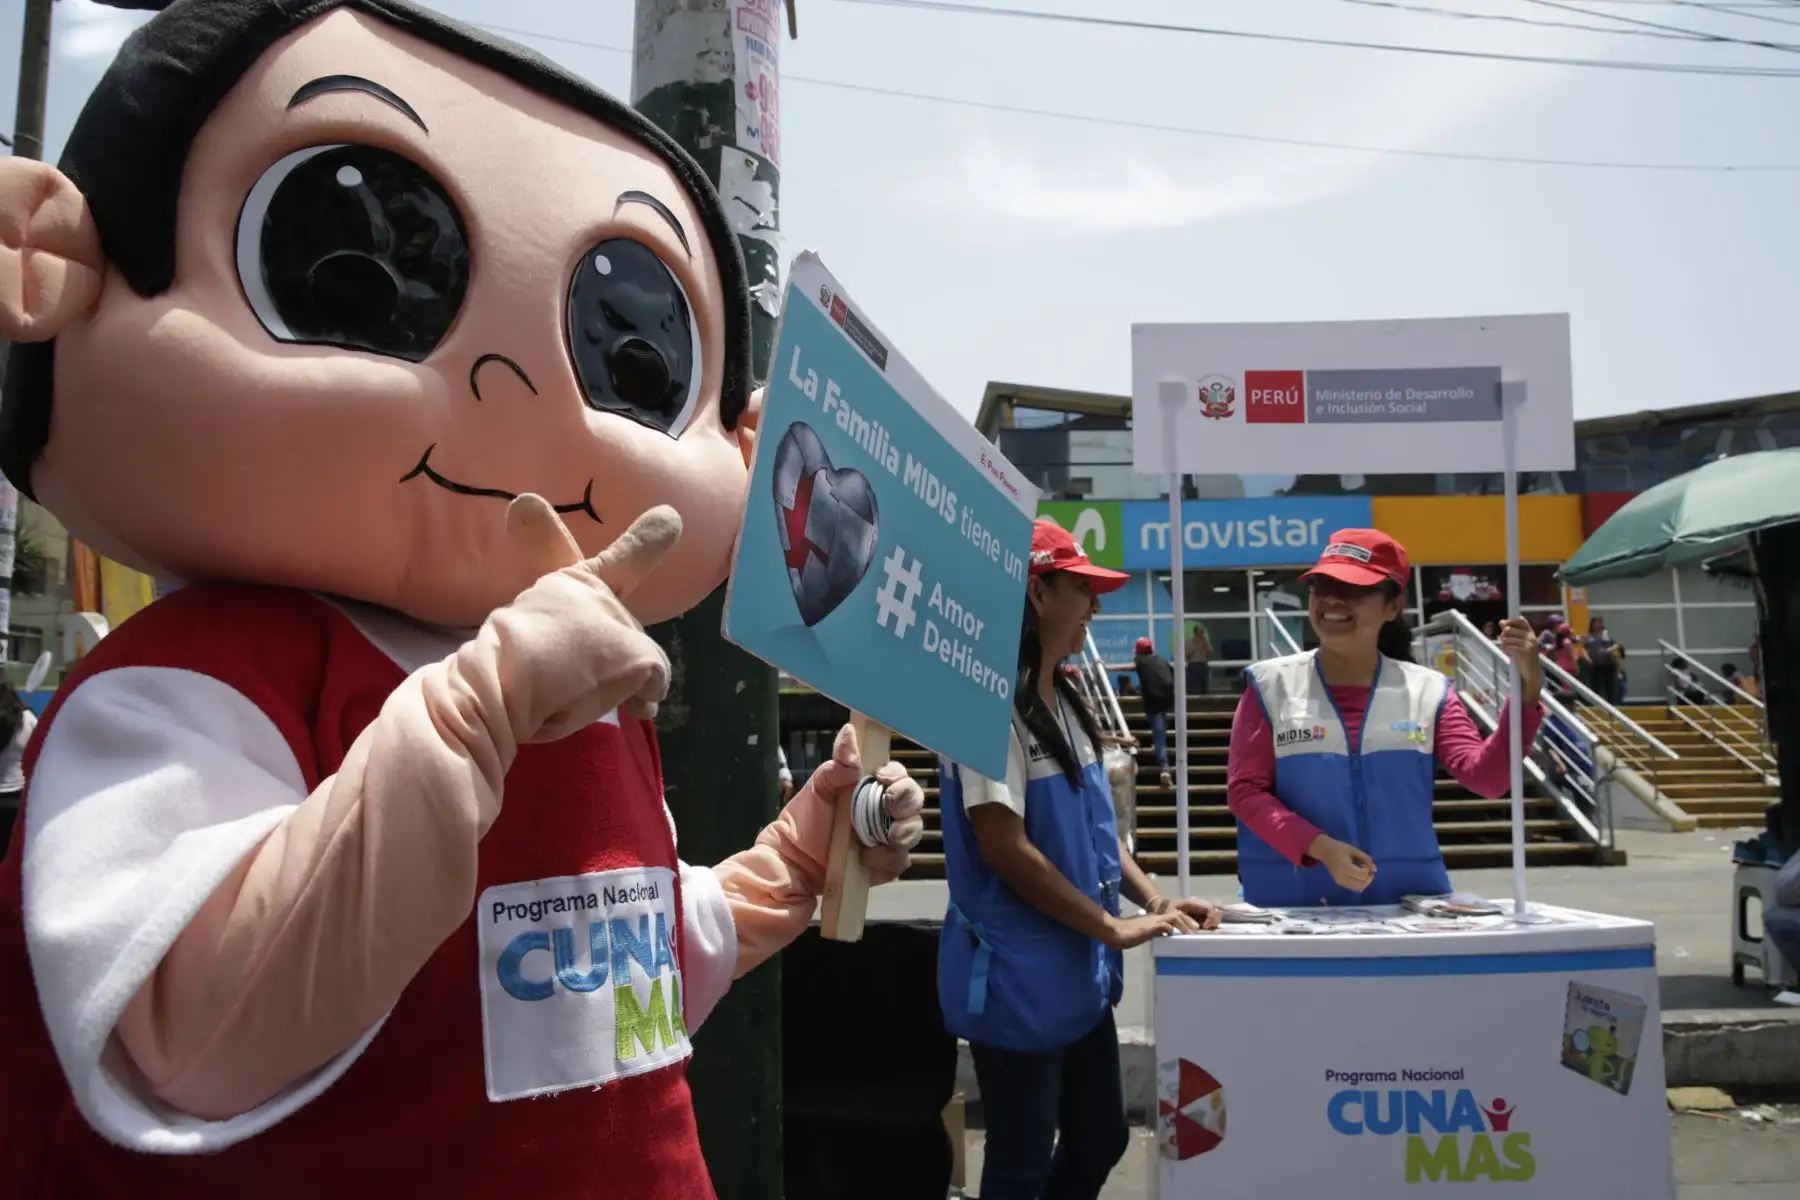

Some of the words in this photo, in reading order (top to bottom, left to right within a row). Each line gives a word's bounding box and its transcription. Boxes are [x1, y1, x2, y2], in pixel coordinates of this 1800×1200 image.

[1251, 387, 1298, 405] PERÚ
[1315, 388, 1382, 401] Ministerio
[1385, 387, 1401, 400] de
[1405, 387, 1474, 400] Desarrollo
[1315, 405, 1324, 415] e
[1328, 401, 1386, 415] Inclusión
[1389, 402, 1427, 415] Social
[789, 345, 818, 401] La
[822, 378, 901, 477] Familia
[903, 453, 958, 525] MIDIS
[960, 506, 1001, 562] tiene
[1004, 549, 1023, 582] un
[1141, 514, 1324, 550] movistar
[928, 581, 984, 641] Amor
[923, 619, 1009, 700] DeHierro
[1276, 728, 1311, 744] MIDIS
[493, 893, 598, 923] Programa
[603, 881, 659, 906] Nacional
[497, 912, 676, 1002] CUNA
[615, 974, 688, 1061] MA
[1325, 1069, 1397, 1085] Programa
[1402, 1067, 1464, 1081] Nacional
[1327, 1089, 1486, 1136] CUNA
[1405, 1132, 1536, 1184] MAS
